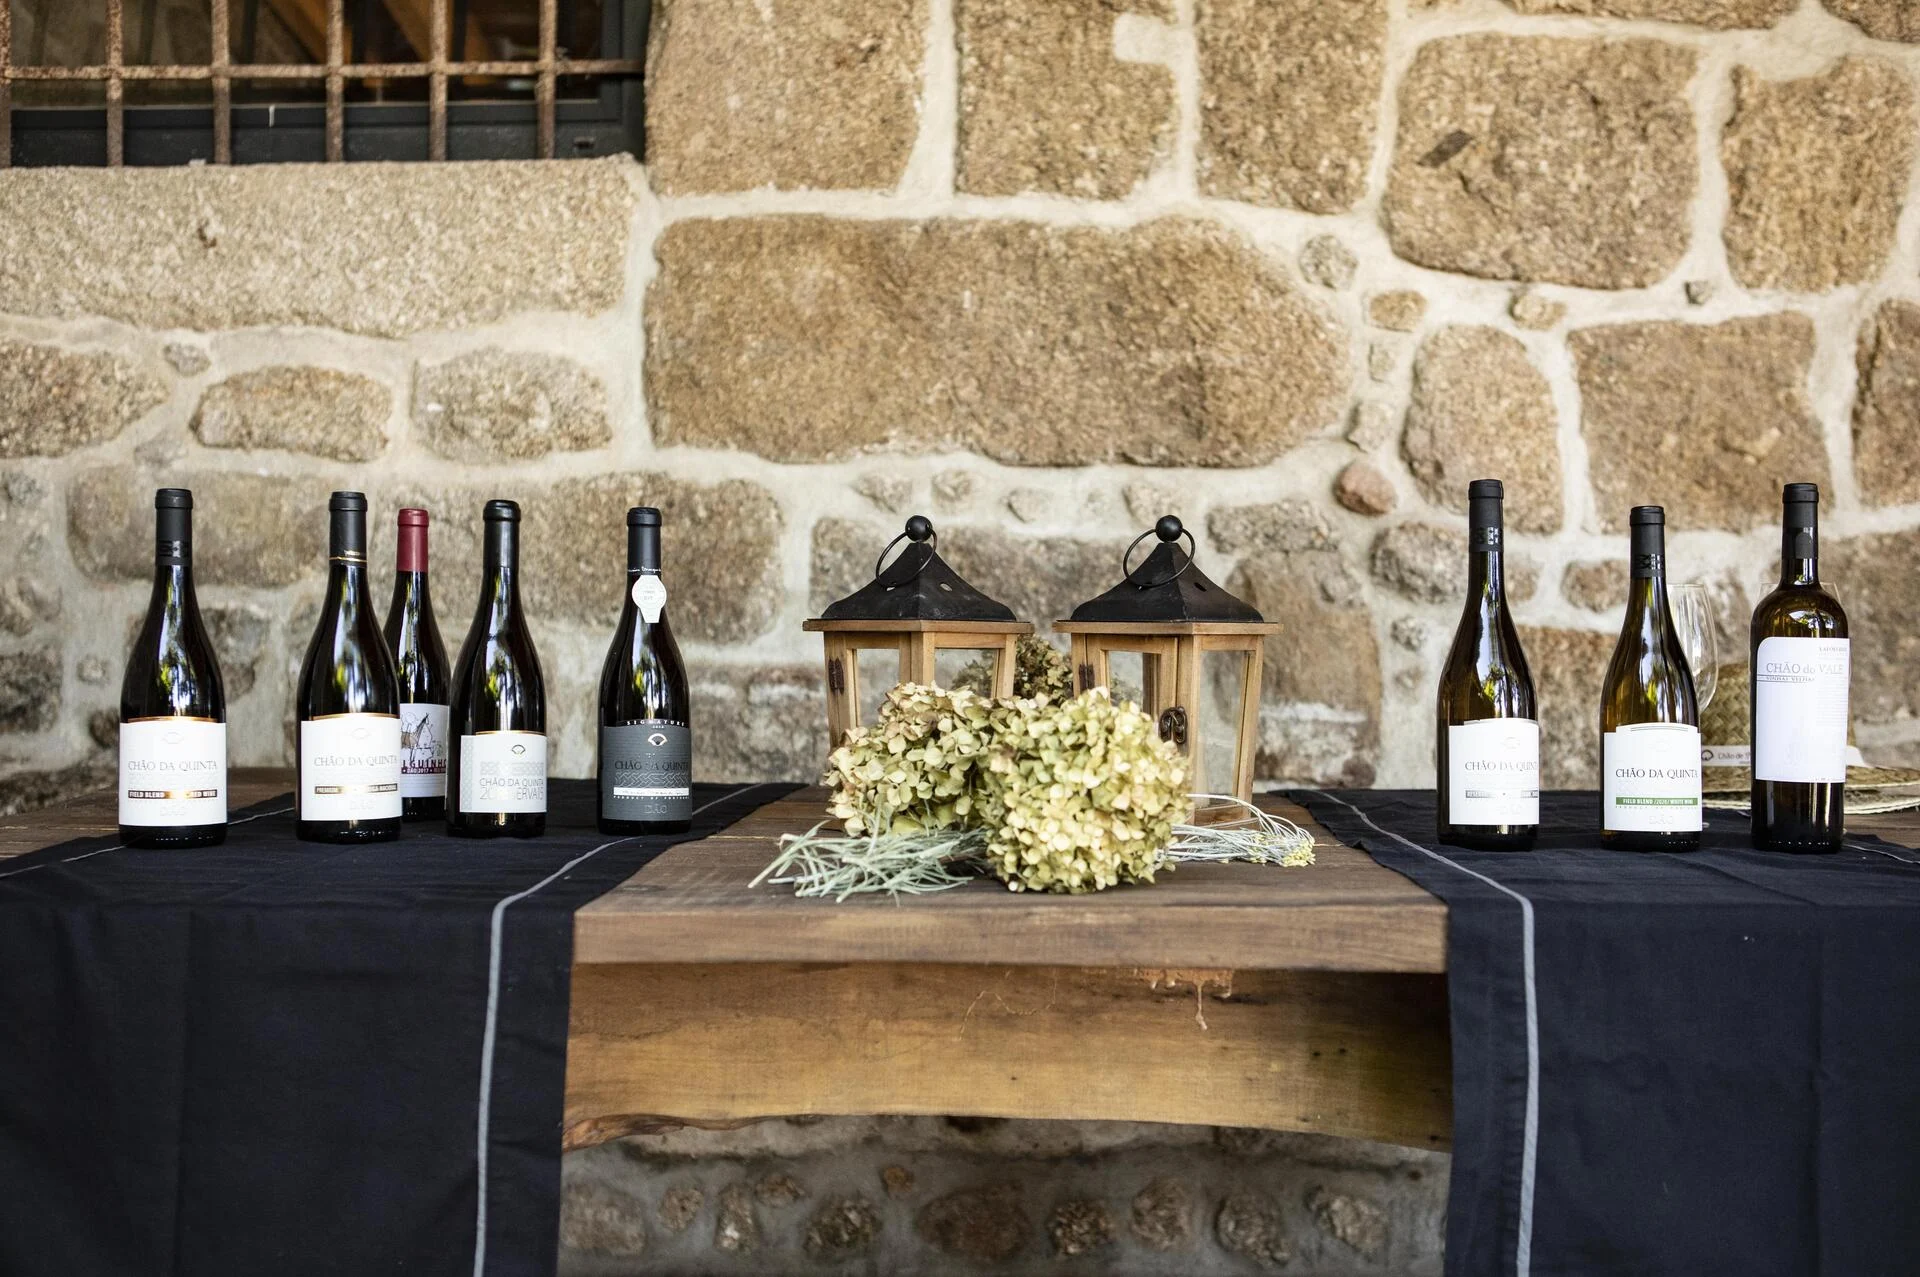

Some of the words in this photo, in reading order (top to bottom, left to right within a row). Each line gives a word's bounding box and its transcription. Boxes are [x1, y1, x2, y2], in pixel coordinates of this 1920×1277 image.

[1766, 661, 1800, 674] CHÃO
[1802, 664, 1815, 674] do
[1819, 664, 1844, 674] VALE
[128, 760, 156, 771] CHÃO
[160, 761, 175, 771] DA
[179, 760, 217, 772] QUINTA
[314, 755, 344, 767] CHÃO
[348, 757, 364, 767] DA
[366, 755, 397, 767] QUINTA
[615, 760, 643, 771] CHÃO
[1465, 760, 1497, 771] CHÃO
[1499, 761, 1514, 771] DA
[1616, 767, 1645, 778] CHÃO
[1649, 769, 1663, 778] DA
[1667, 768, 1698, 779] QUINTA
[480, 777, 505, 787] CHÃO
[508, 778, 519, 787] DA
[522, 779, 544, 787] QUINTA
